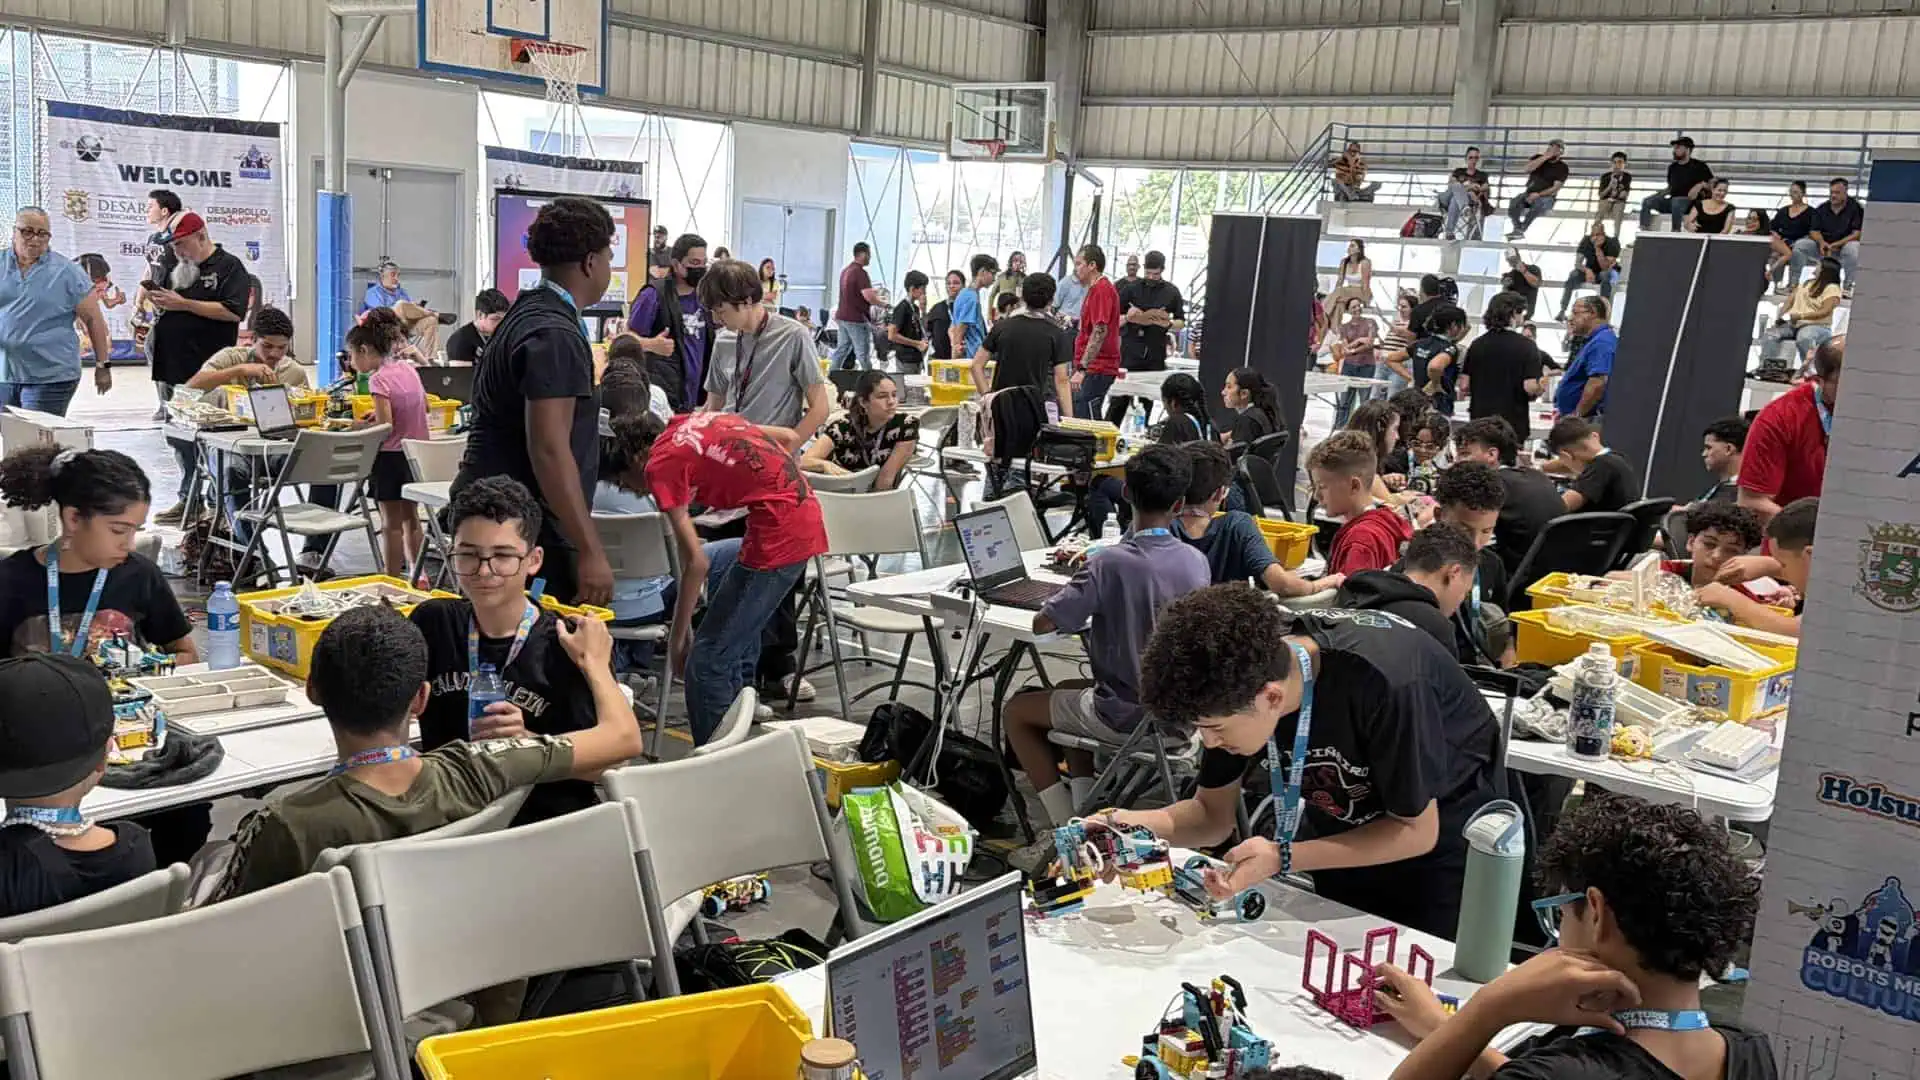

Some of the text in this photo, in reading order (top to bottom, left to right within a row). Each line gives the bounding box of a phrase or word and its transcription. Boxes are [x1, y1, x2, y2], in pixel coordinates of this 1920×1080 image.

[117, 163, 232, 188] WELCOME
[98, 199, 147, 214] DESAR
[1821, 775, 1920, 821] Holsu
[1802, 964, 1920, 1022] CULTUR
[1807, 950, 1920, 998] ROBOTS ME
